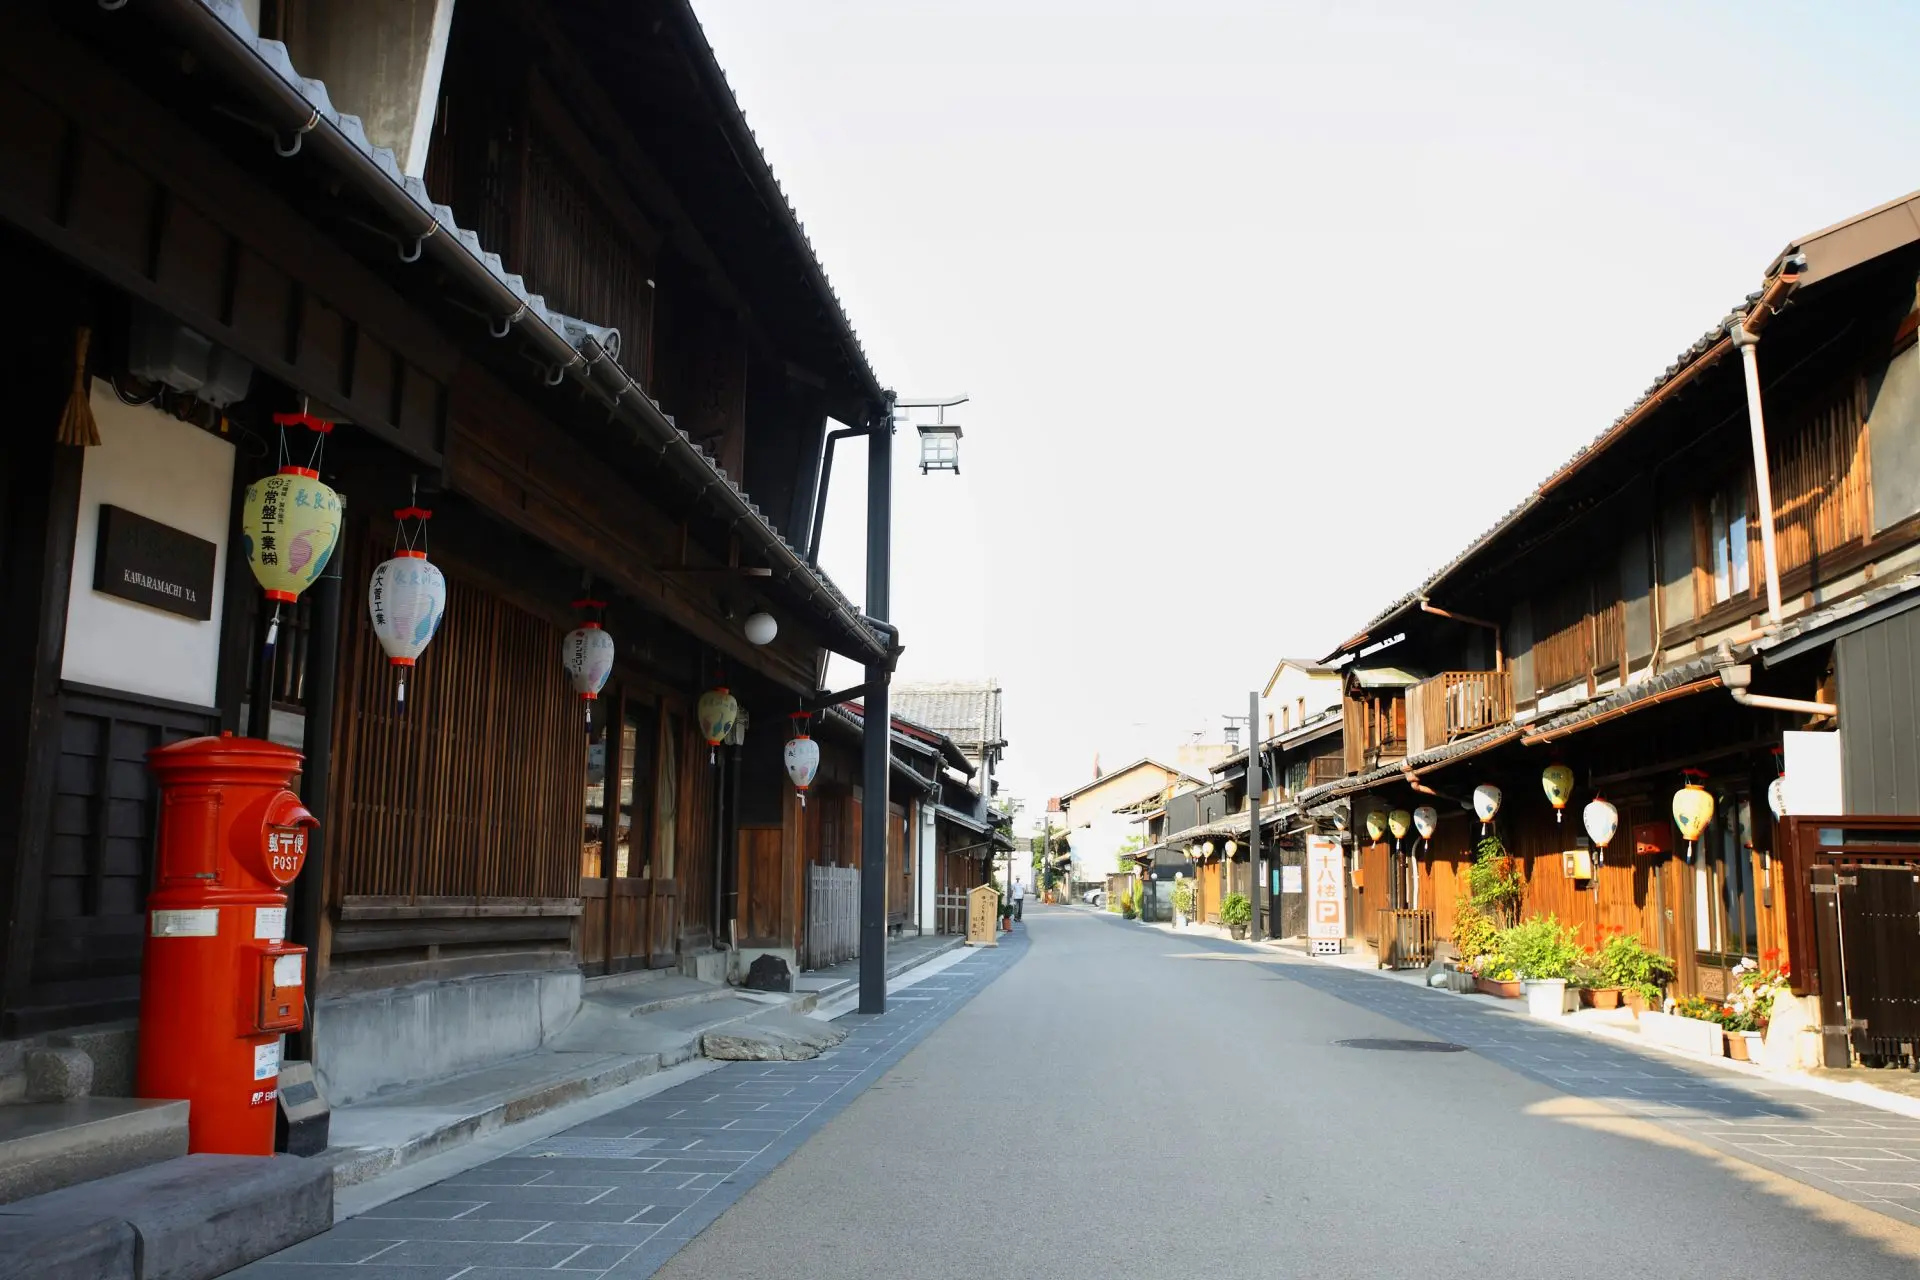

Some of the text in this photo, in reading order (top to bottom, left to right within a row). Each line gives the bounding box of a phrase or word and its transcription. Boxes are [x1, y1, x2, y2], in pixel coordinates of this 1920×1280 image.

[124, 569, 196, 602] KAWARAMACHI YA
[273, 855, 298, 871] POST
[1320, 905, 1336, 922] P
